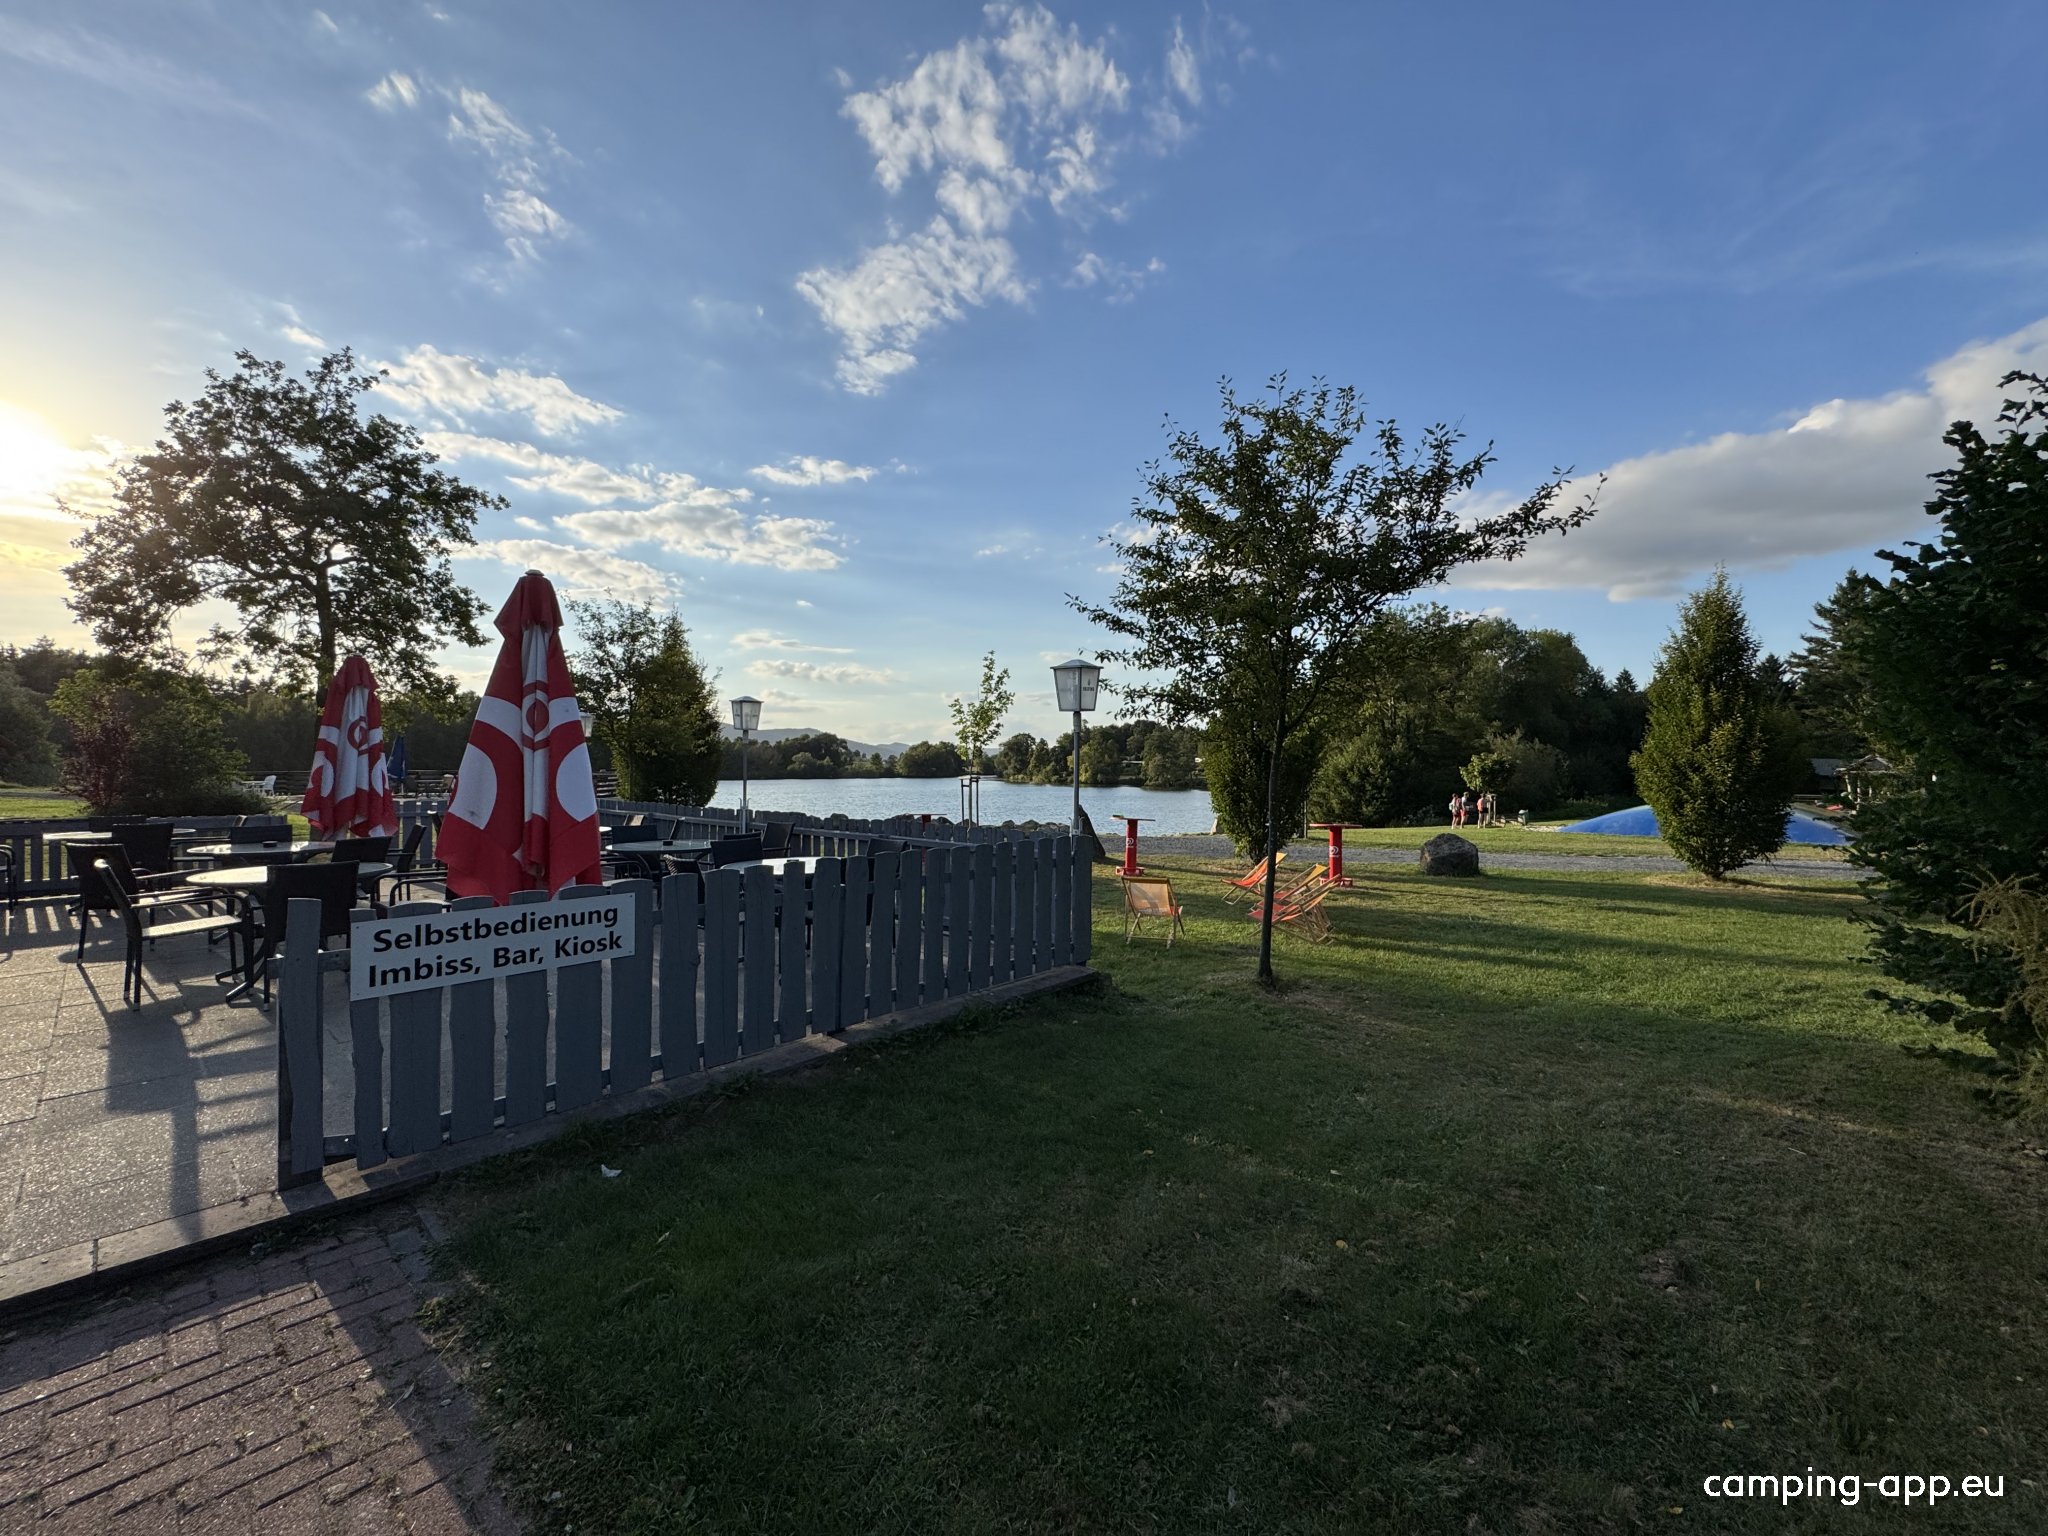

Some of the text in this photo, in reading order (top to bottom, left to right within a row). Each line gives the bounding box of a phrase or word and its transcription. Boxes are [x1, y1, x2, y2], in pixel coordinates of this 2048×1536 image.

[373, 907, 618, 952] Selbstbedienung
[368, 931, 623, 987] Imbiss, Bar, Kiosk
